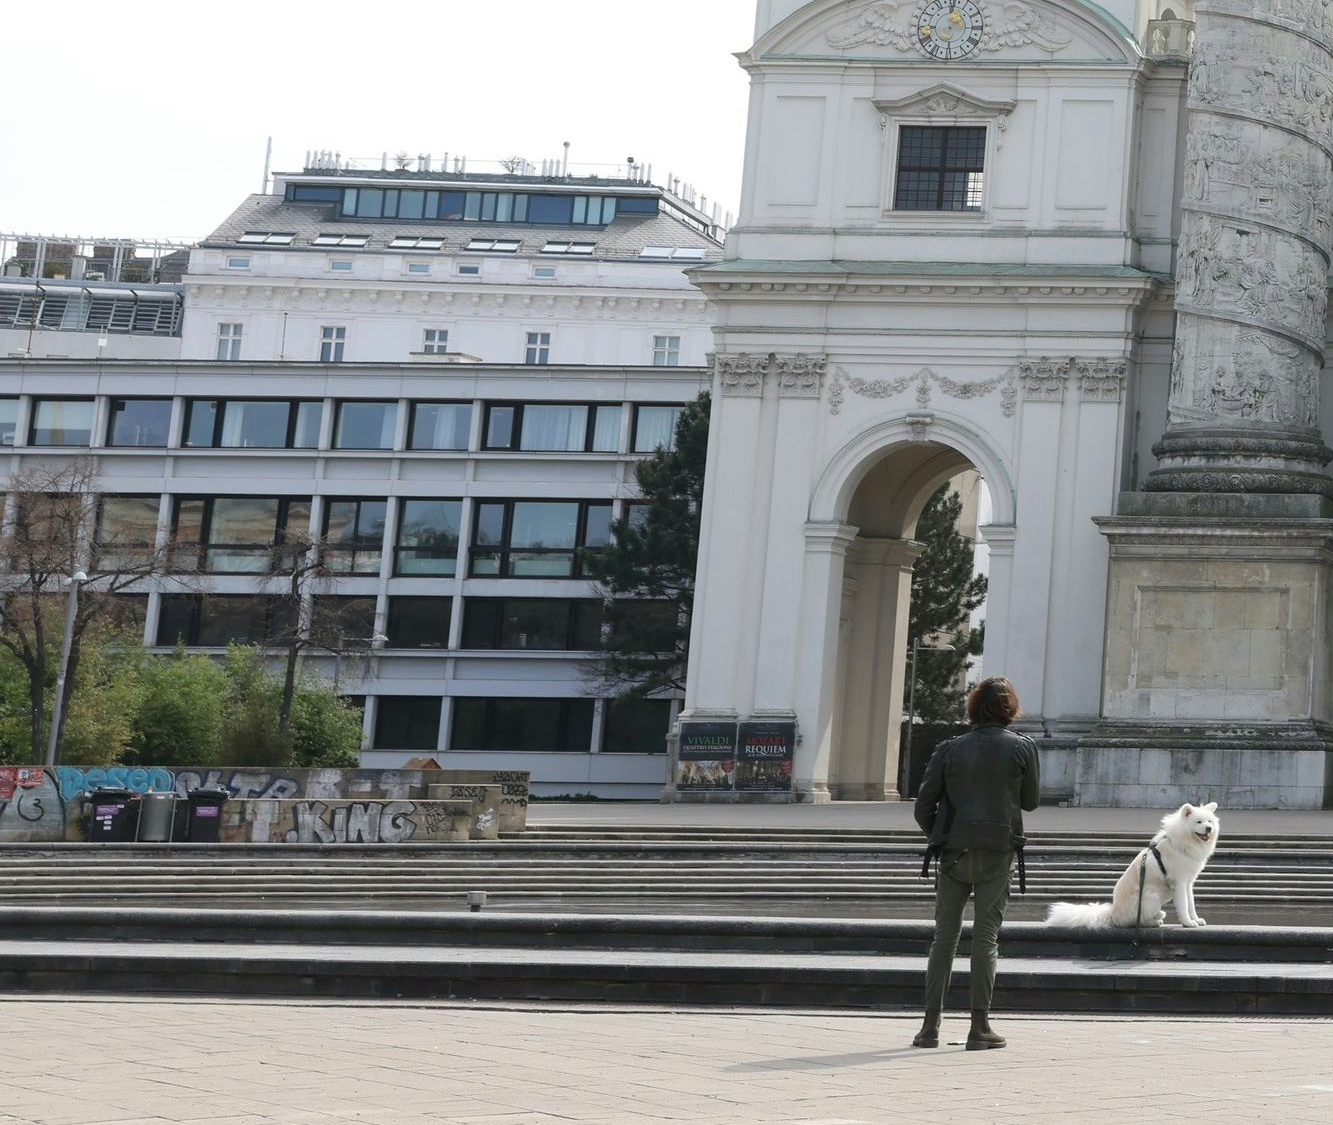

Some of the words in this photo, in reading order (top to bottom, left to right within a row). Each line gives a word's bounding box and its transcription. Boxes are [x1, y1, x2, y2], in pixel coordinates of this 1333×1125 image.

[688, 736, 729, 745] VIVALDI
[746, 736, 786, 745] MOZART
[745, 745, 787, 754] REQUIEM
